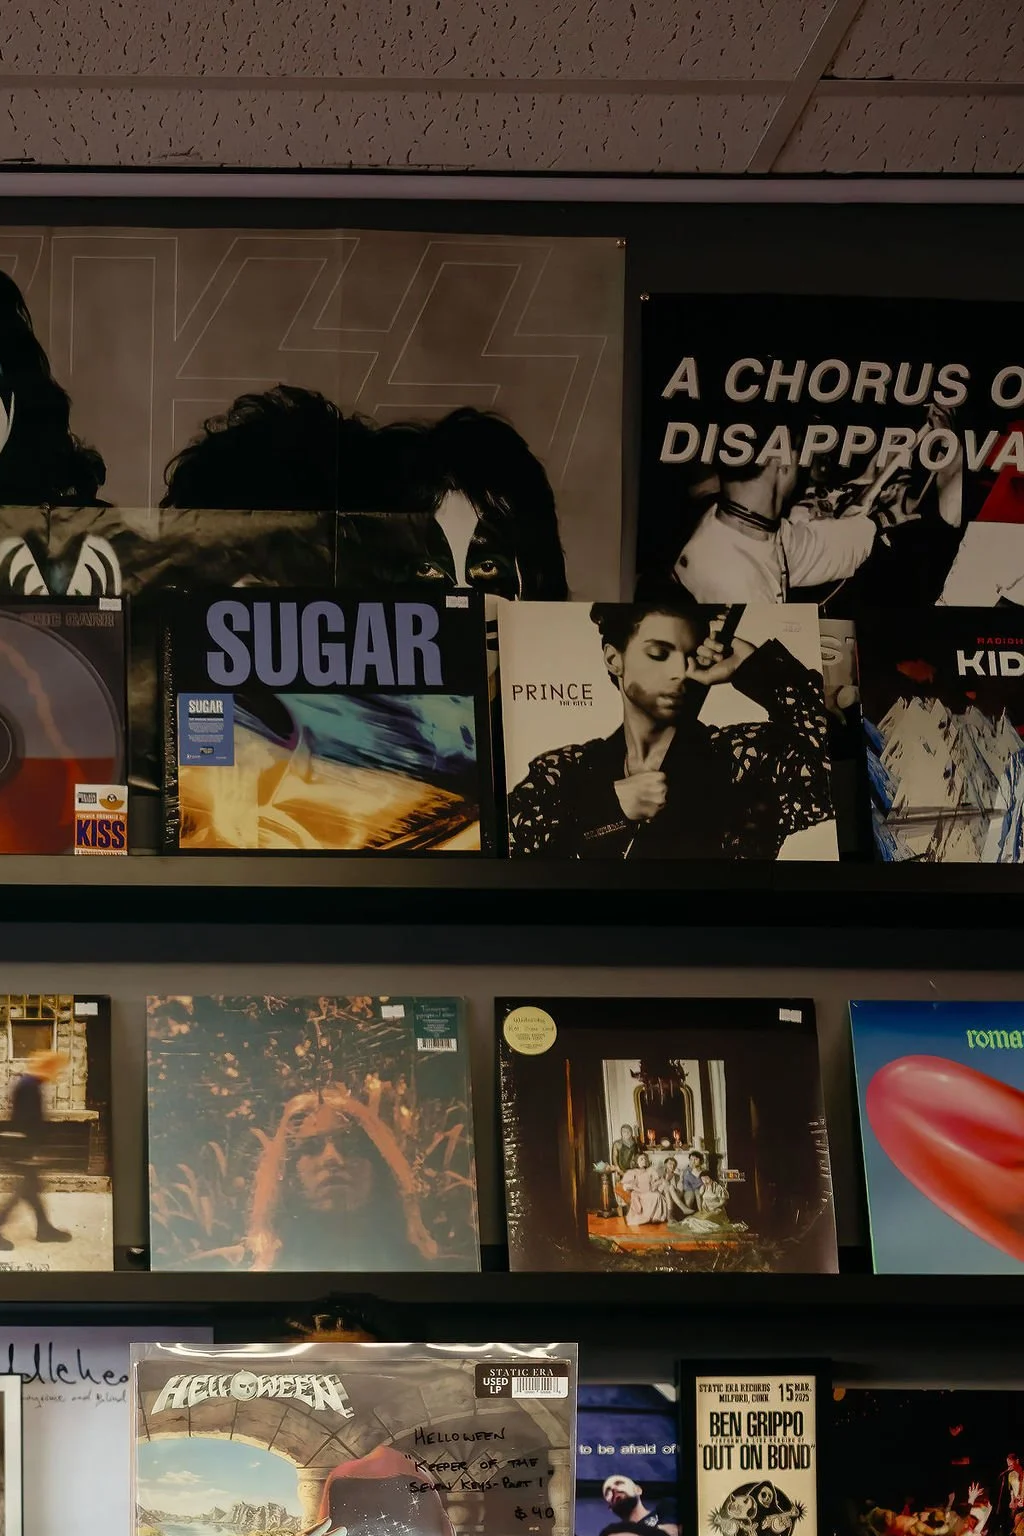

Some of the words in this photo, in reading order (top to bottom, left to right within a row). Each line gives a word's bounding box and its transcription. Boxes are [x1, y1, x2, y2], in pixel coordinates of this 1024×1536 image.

[661, 356, 702, 401] A
[724, 357, 972, 409] CHORUS
[206, 600, 444, 687] SUGAR
[957, 650, 1024, 677] KID
[512, 683, 593, 701] PRINCE
[188, 699, 224, 714] SUGAR
[77, 819, 125, 849] KISS
[489, 1368, 529, 1377] STATIC
[532, 1368, 554, 1377] ERA
[483, 1377, 509, 1387] USED
[489, 1386, 502, 1394] LP
[151, 1369, 355, 1420] HELLOWEEN
[698, 1384, 724, 1393] STATIC
[779, 1383, 794, 1402] 15
[710, 1411, 742, 1437] BEN
[747, 1411, 804, 1437] GRIPPO
[579, 1444, 593, 1455] to
[597, 1444, 616, 1455] be
[619, 1444, 657, 1455] afraid
[740, 1444, 763, 1470] ON
[480, 1459, 498, 1470] OF
[508, 1458, 539, 1469] THE
[409, 1482, 453, 1493] SEVEN
